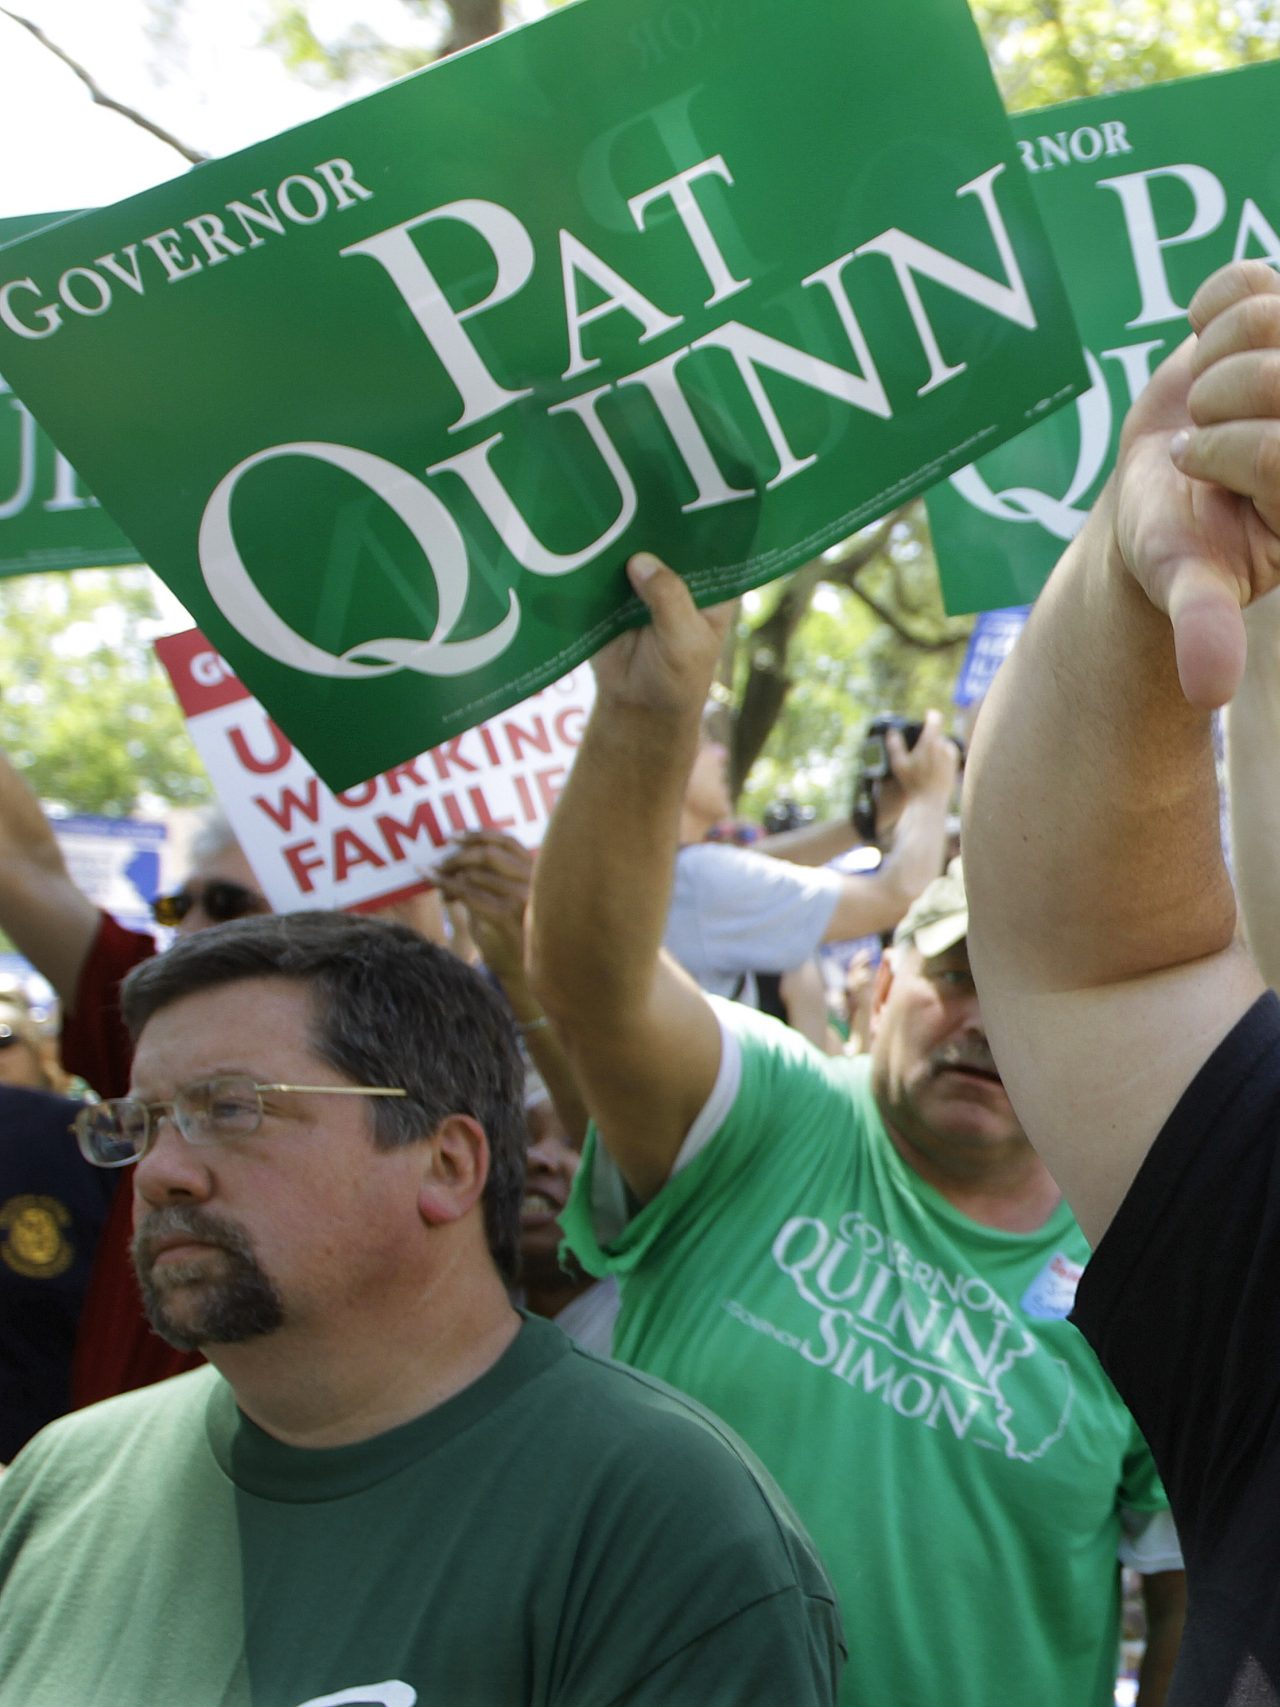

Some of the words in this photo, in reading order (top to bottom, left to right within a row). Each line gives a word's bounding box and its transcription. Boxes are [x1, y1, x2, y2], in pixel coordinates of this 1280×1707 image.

[1016, 120, 1133, 174] RNOR
[0, 157, 373, 340] GOVERNOR
[339, 154, 753, 433] PAT
[199, 163, 1038, 679] QUINN
[282, 766, 565, 894] FAMILIE
[771, 1215, 1009, 1379] QUINN
[799, 1309, 983, 1440] SIMON
